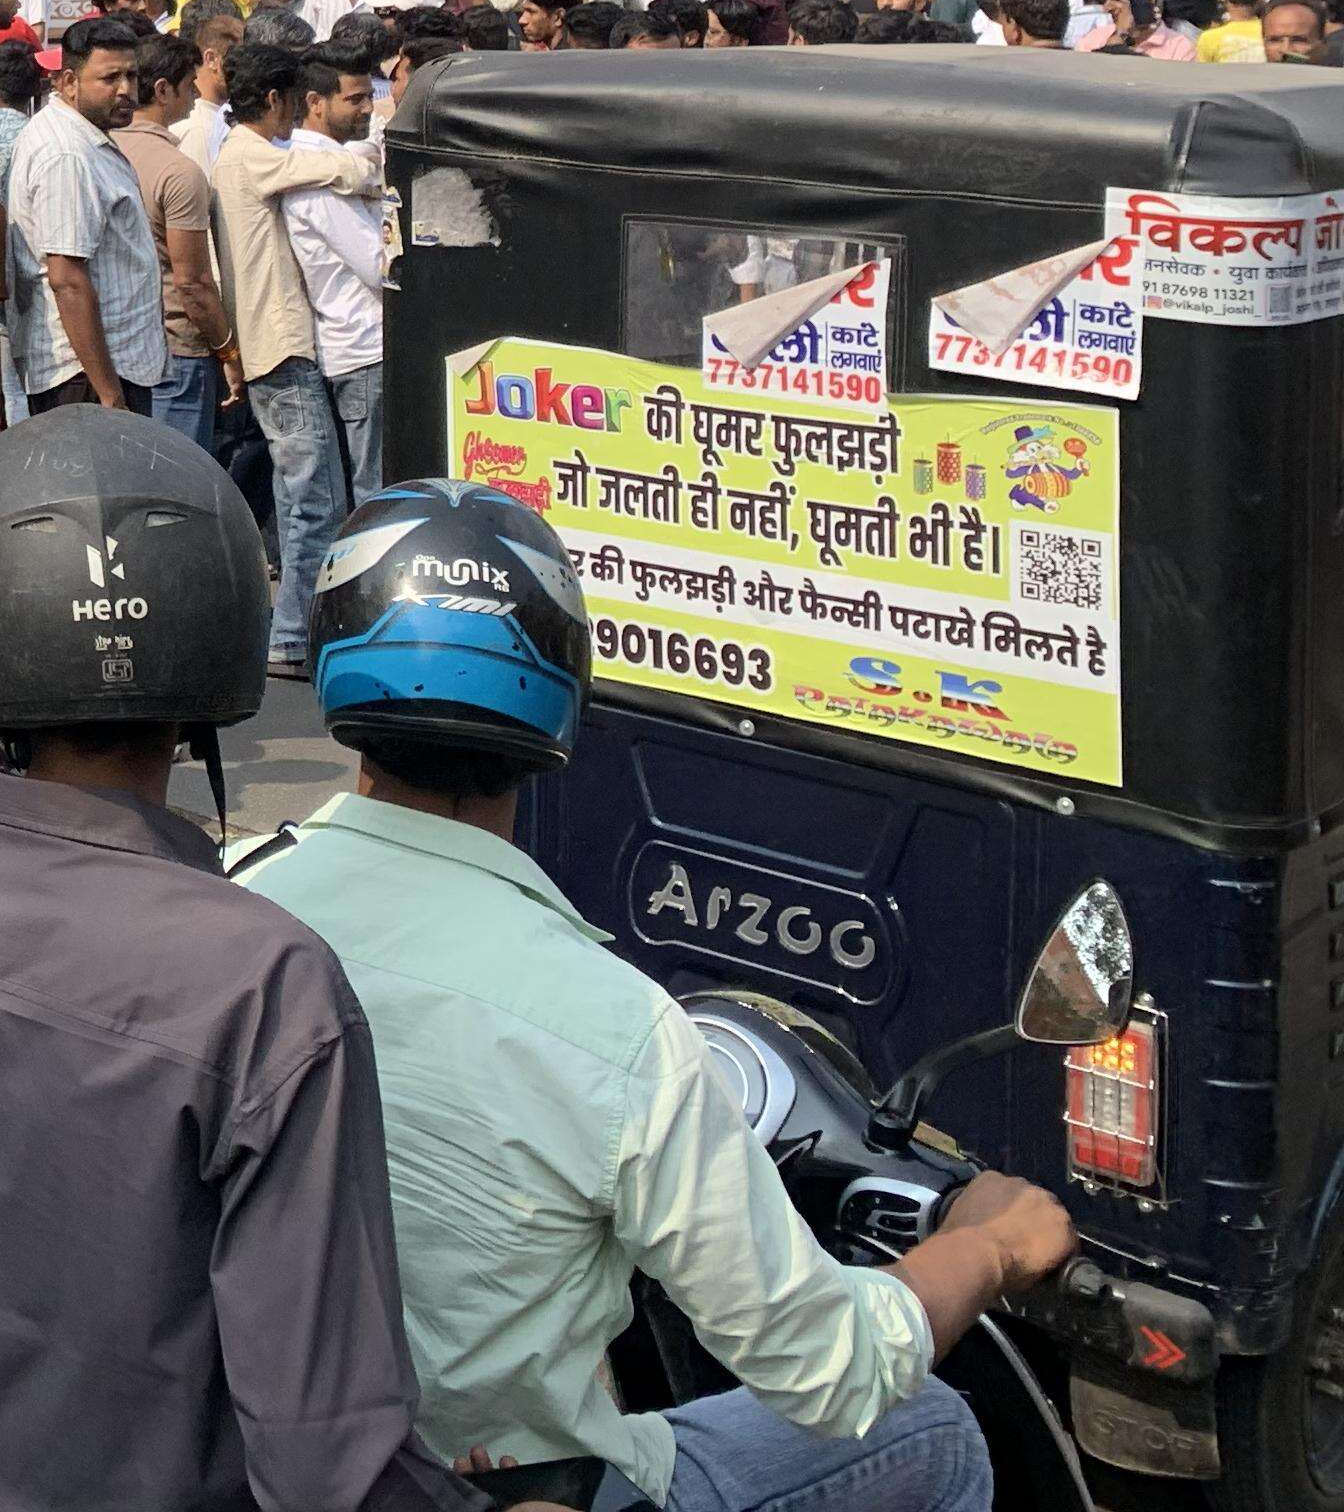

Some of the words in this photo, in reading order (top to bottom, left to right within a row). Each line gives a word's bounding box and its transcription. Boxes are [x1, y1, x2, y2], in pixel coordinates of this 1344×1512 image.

[1125, 194, 1306, 261] विकल्प
[1315, 197, 1344, 251] जो
[1162, 281, 1208, 299] 87698
[1213, 288, 1255, 301] 11321
[1229, 266, 1260, 285] युवा
[831, 349, 883, 373] लगवाएं
[1078, 330, 1136, 356] लगवाएं
[465, 360, 632, 433] Joker
[708, 358, 881, 404] 7737141590
[643, 385, 685, 444] की
[690, 404, 765, 467] घूमर
[770, 412, 902, 485] फुलझड़ी
[553, 450, 591, 508] जो
[595, 464, 683, 524] जलती
[688, 471, 721, 530] ही
[727, 481, 800, 551] नहीं,
[807, 496, 901, 567] घूमती
[909, 502, 954, 567] भी
[72, 597, 149, 622] Hero
[589, 545, 625, 584] की
[629, 560, 737, 613] फुलझड़ी
[743, 570, 793, 616] और
[798, 577, 883, 632] फैन्सी
[888, 606, 977, 648] पटाखे
[982, 611, 1080, 668] मिलते
[1085, 625, 1107, 677] है
[589, 618, 773, 691] 9016693
[647, 862, 876, 969] Arzoo
